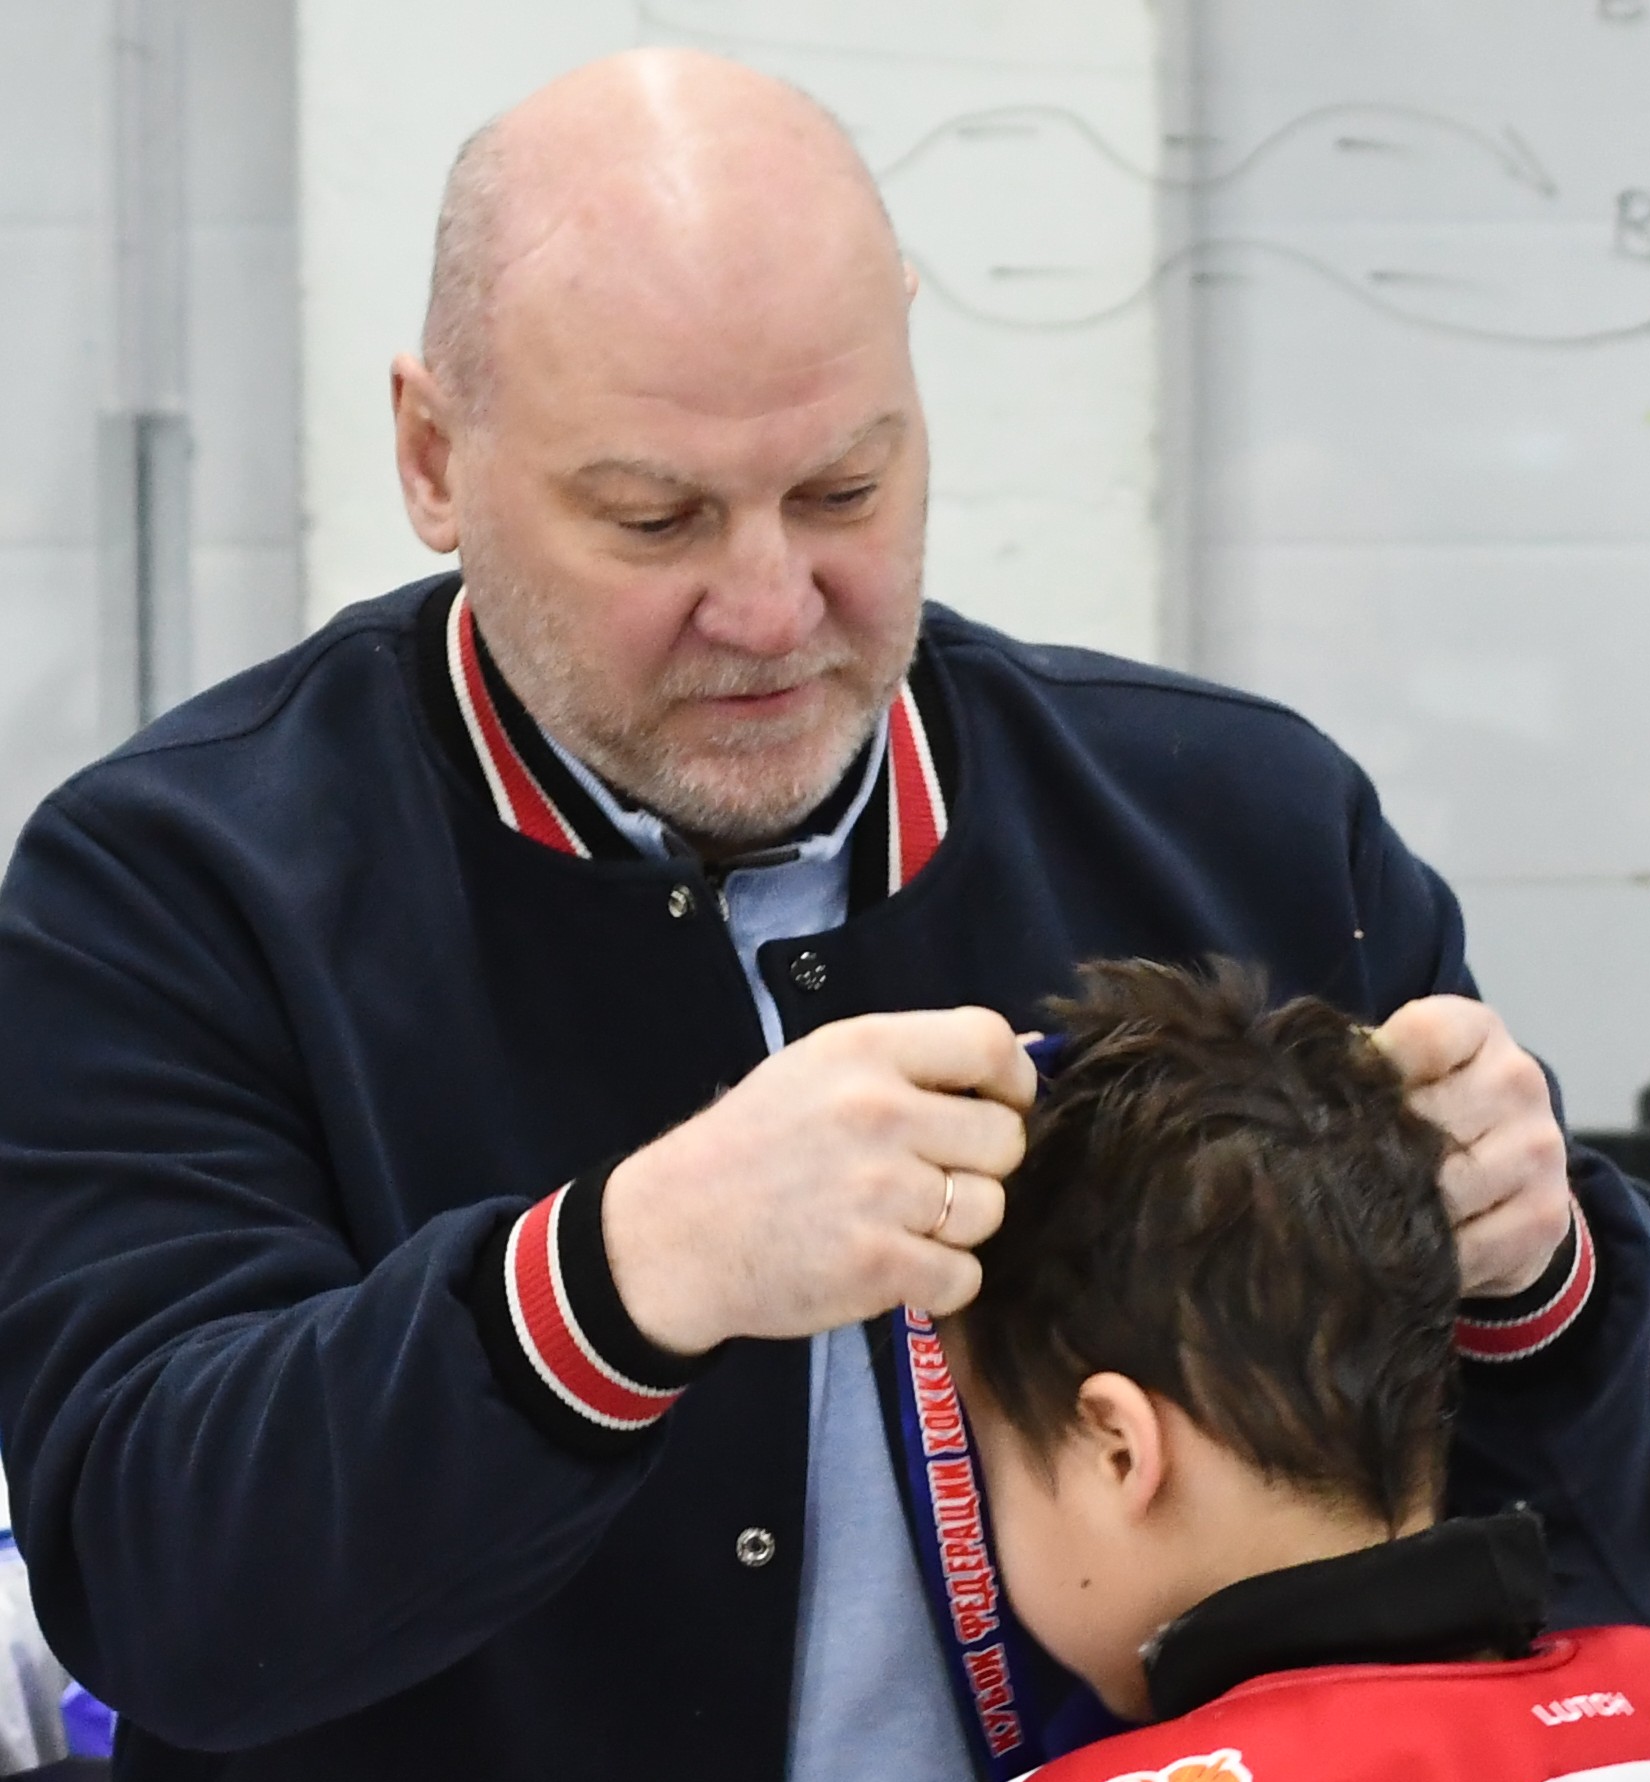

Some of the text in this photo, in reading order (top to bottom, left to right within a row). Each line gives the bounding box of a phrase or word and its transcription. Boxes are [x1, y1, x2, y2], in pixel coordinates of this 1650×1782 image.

[907, 1332, 968, 1457] ХОККЕЯ
[926, 1455, 999, 1643] ФЕДЕРАЦИИ
[964, 1643, 1022, 1757] КУБОК
